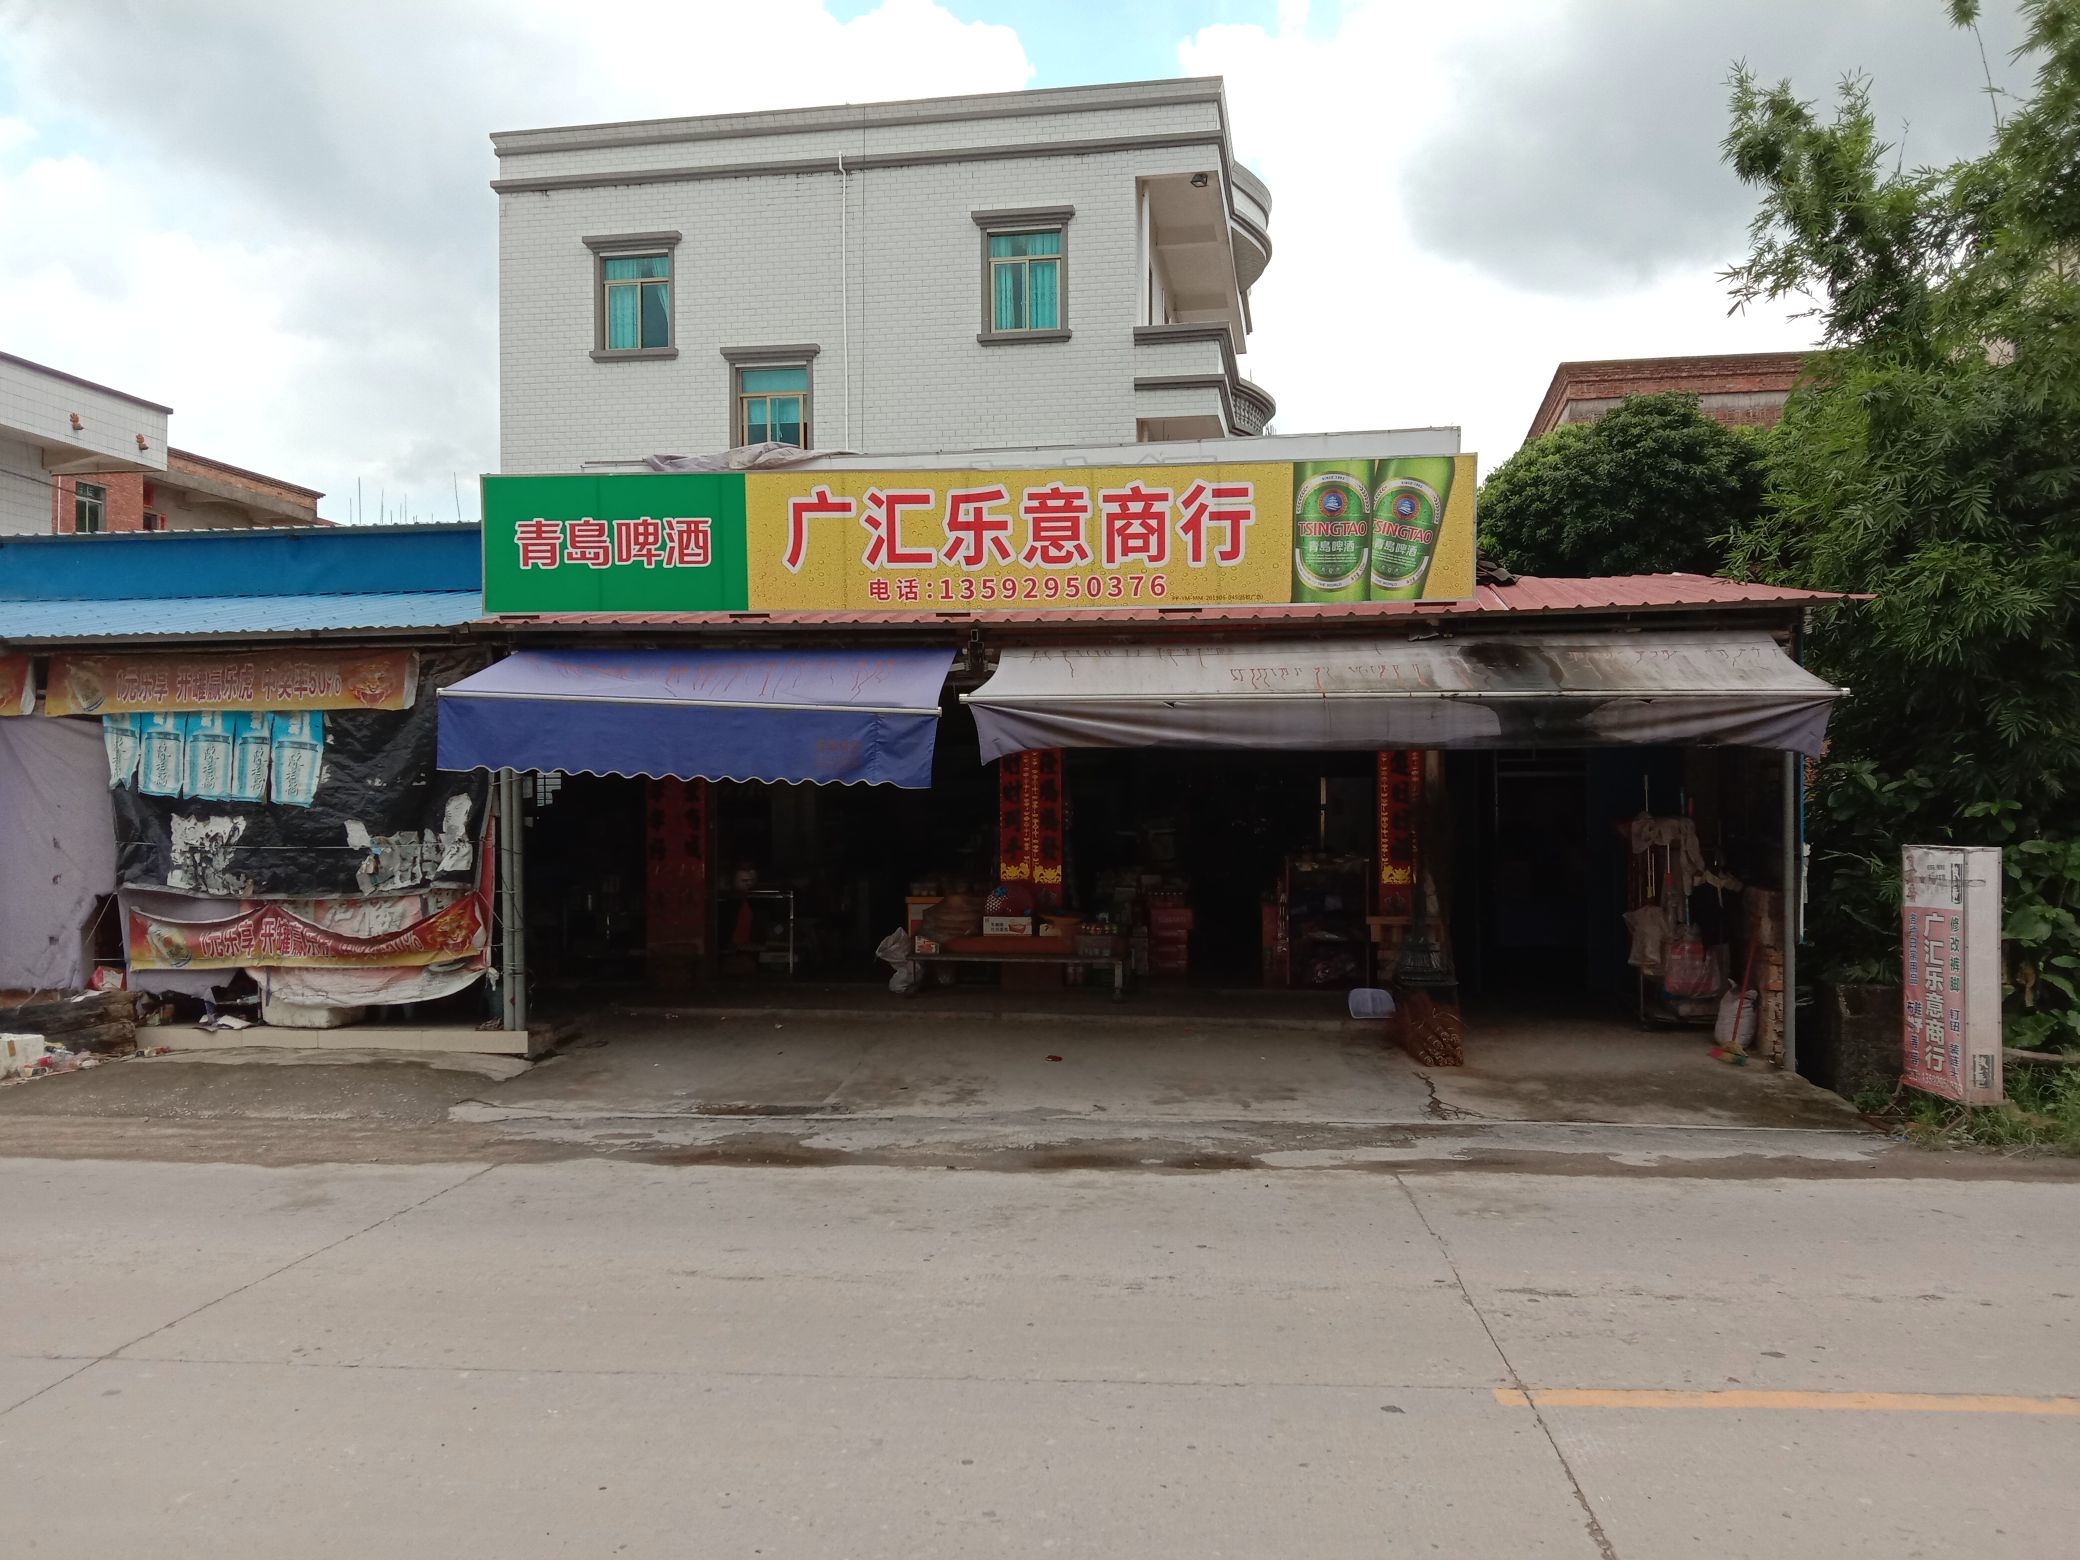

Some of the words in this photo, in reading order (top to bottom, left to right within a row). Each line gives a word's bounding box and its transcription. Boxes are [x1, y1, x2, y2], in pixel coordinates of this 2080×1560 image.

[514, 517, 712, 569] 青島啤酒
[784, 480, 1255, 570] 广汇乐意商行
[1298, 521, 1367, 537] TSINGTAO
[868, 574, 1167, 603] 电话:13592950376
[1923, 912, 1945, 1073] 广汇乐意商行
